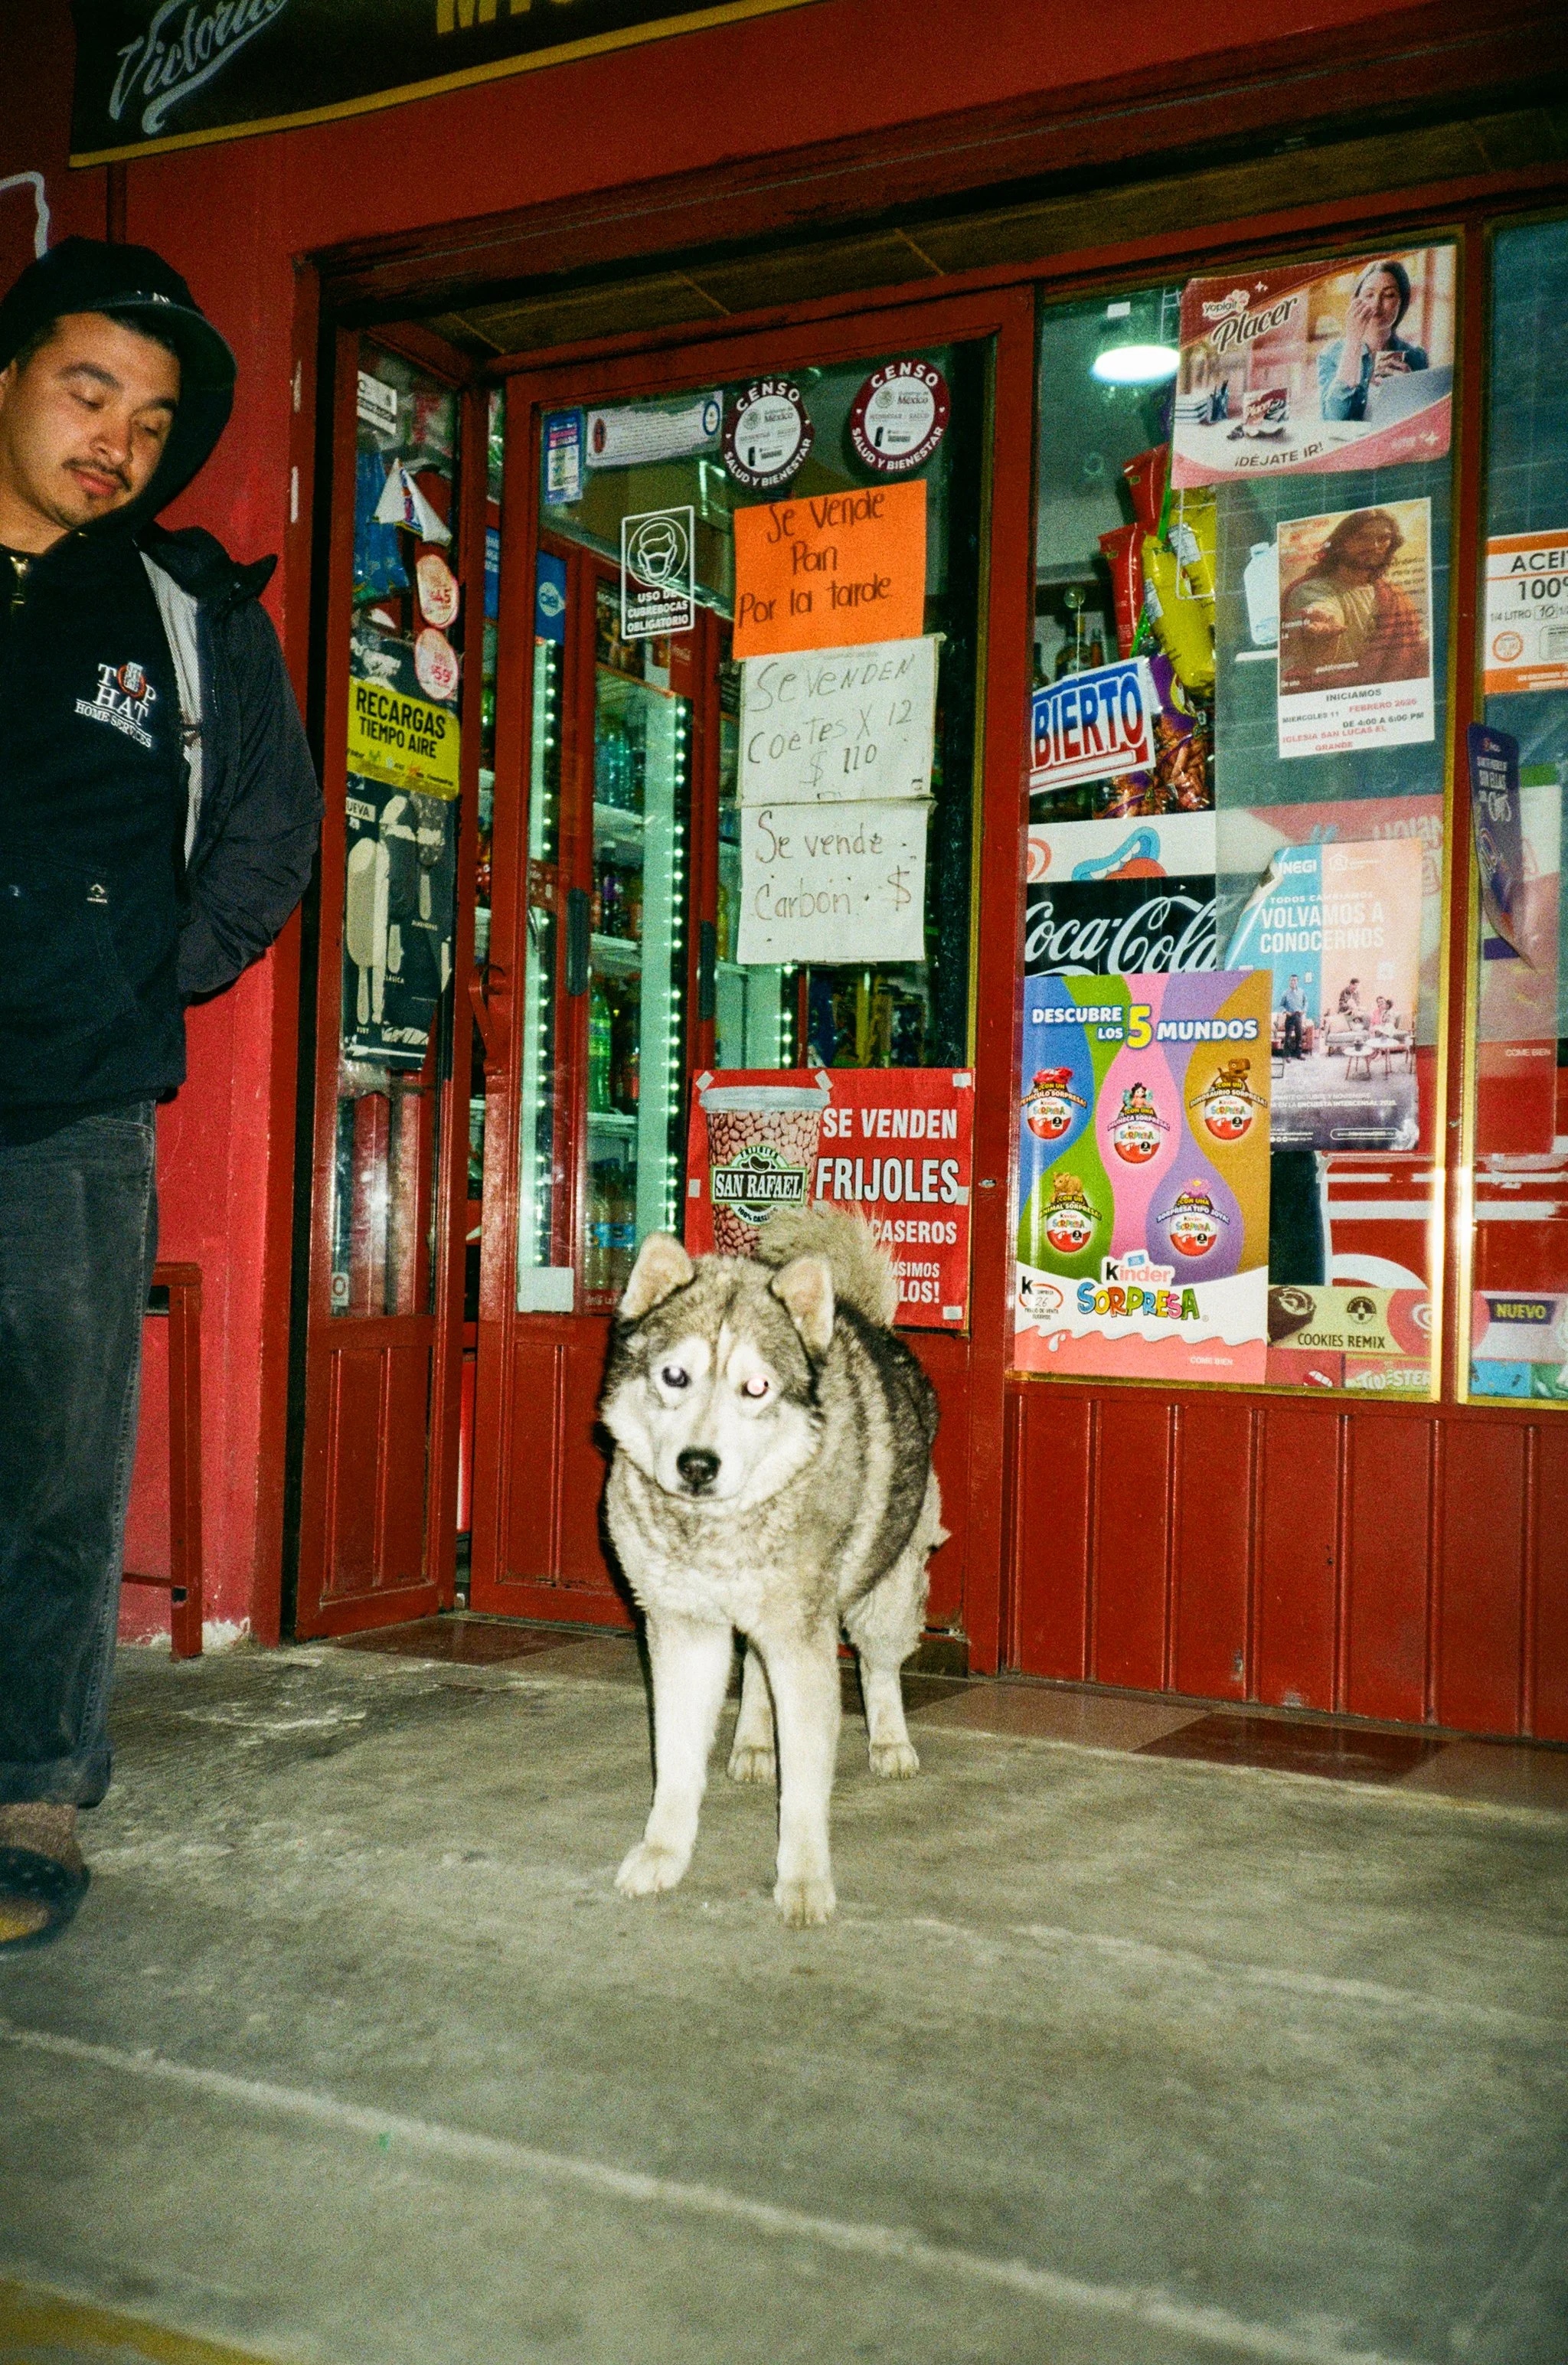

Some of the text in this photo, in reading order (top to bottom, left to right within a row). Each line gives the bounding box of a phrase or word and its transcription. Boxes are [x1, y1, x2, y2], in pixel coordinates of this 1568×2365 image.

[1213, 296, 1298, 352] Placer
[871, 362, 939, 388] CENSO
[737, 382, 800, 411] CENSO
[851, 426, 944, 470] SALUD Y BIENESTAR
[1304, 442, 1323, 457] IR!
[724, 451, 750, 483] SALUD
[752, 477, 760, 486] Y
[761, 438, 812, 486] BIENESTAR
[766, 502, 795, 544] Se
[792, 541, 838, 576] Pan
[638, 592, 659, 603] USO
[739, 573, 891, 629] Por la tarde
[626, 614, 689, 632] OBLIGATORIO
[1504, 609, 1531, 621] LITRO
[98, 661, 156, 706] TOP
[1326, 689, 1381, 702] INICIAMOS
[93, 683, 149, 727] HAT
[356, 687, 446, 740] RECARGAS
[888, 699, 914, 726] 12
[1348, 702, 1392, 712] FEBRERO
[74, 701, 152, 749] HOME SERVICES
[1032, 671, 1145, 771] BIERTO
[1357, 717, 1377, 727] 4:00
[1410, 711, 1424, 720] PM
[358, 716, 438, 759] TIEMPO AIRE
[1282, 724, 1387, 744] IGLESIA SAN LUCAS EL
[1315, 741, 1354, 752] GRANDE
[799, 743, 878, 787] $ 110
[347, 802, 371, 818] UEVA
[754, 810, 884, 864] Se vende
[1279, 859, 1318, 874] INEGI
[887, 865, 912, 912] $
[1270, 896, 1306, 904] TODOS
[1262, 901, 1386, 929] VOLVAMOS A
[1259, 926, 1385, 954] CONOCERNOS
[1031, 1005, 1123, 1024] DESCUBRE
[1096, 1004, 1258, 1049] LOS 5 MUNDOS
[1190, 1089, 1230, 1108] DINOSAURIO
[822, 1108, 957, 1139] SE VENDEN
[715, 1173, 802, 1199] SAN RAFAEL
[815, 1157, 960, 1204] FRIJOLES
[1194, 1206, 1210, 1214] TIPO
[870, 1219, 957, 1245] CASEROS
[1035, 1297, 1048, 1307] 26
[1077, 1282, 1200, 1321] SORPRESA
[1495, 1303, 1547, 1319] NUEVO
[1297, 1333, 1387, 1350] COOKIES REMIX
